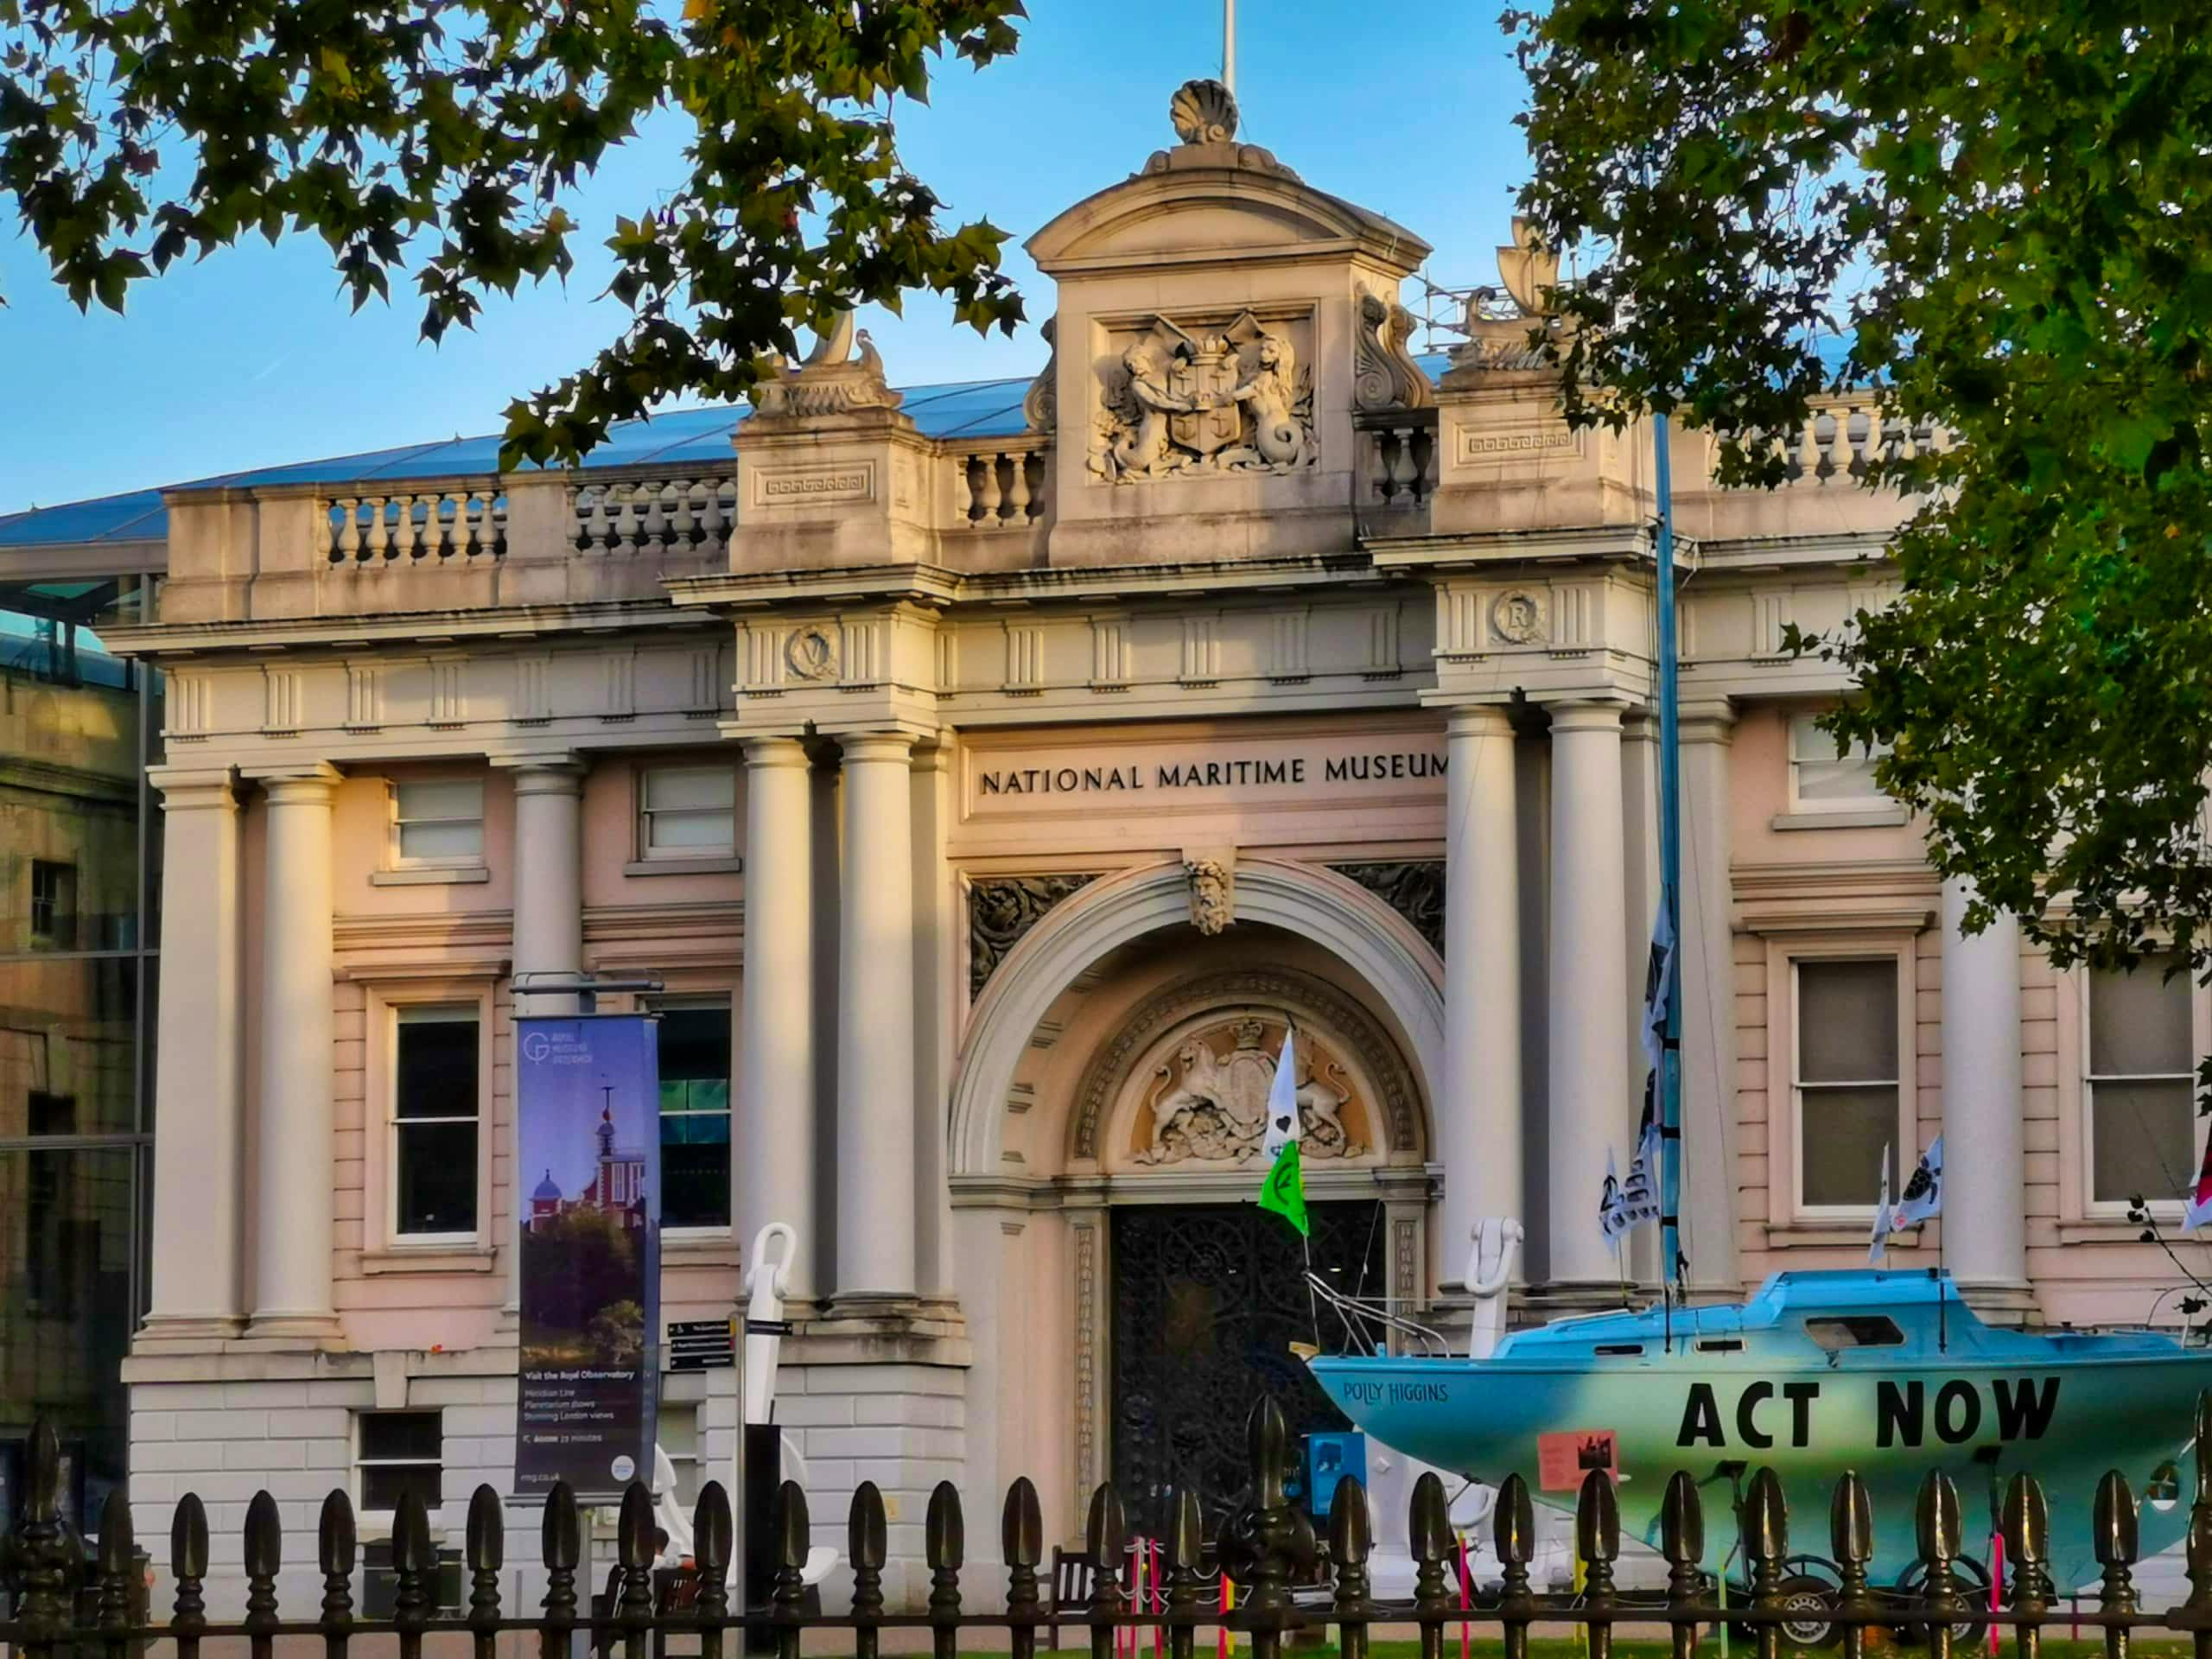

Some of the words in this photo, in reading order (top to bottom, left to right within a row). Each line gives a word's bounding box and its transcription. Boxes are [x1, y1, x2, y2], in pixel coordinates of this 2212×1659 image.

[980, 766, 1144, 795] NATIONAL
[1159, 759, 1306, 788] MARITIME
[1325, 753, 1449, 782] MUSEUM
[580, 1370, 635, 1382] Observatory
[1344, 1382, 1382, 1406] POLLY
[1389, 1382, 1449, 1406] HIGGINS
[1676, 1381, 1820, 1449] ACT
[1876, 1376, 2061, 1448] NOW
